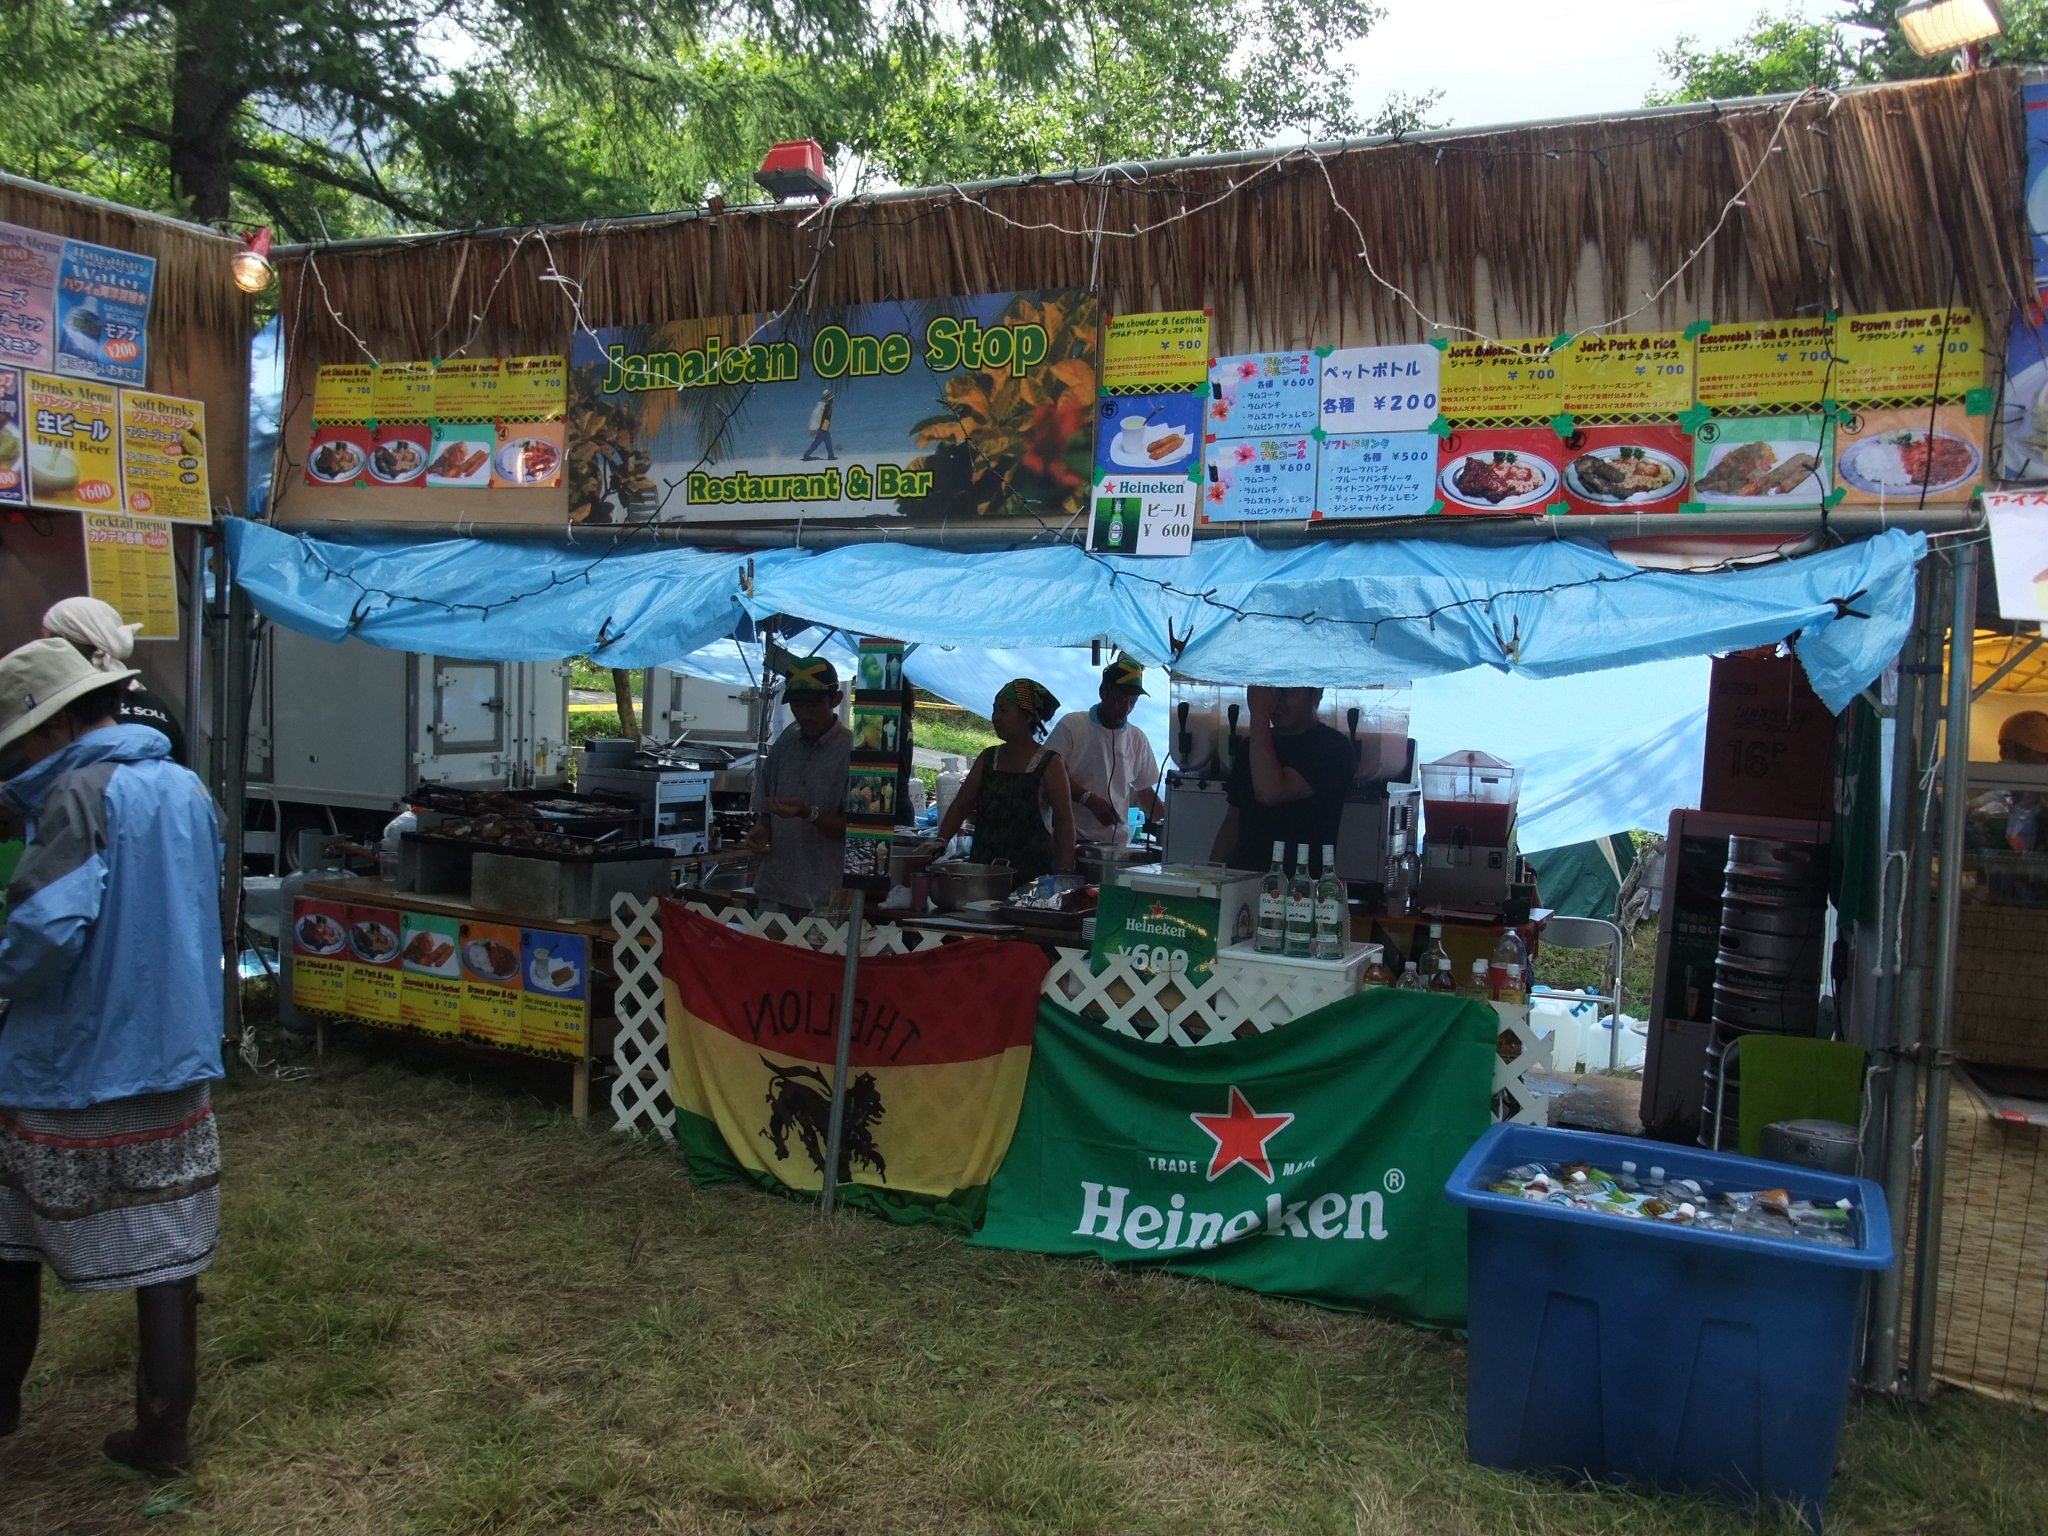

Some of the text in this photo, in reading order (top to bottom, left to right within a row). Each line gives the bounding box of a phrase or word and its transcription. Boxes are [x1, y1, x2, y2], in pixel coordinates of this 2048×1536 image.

[72, 264, 143, 290] Water
[1126, 317, 1160, 328] chowder
[1171, 315, 1207, 325] festivals
[1850, 319, 1891, 333] Brown
[1895, 316, 1927, 330] stew
[1930, 313, 1942, 326] &
[104, 323, 141, 341] モアナ
[1754, 328, 1777, 340] Fish
[1779, 327, 1789, 339] &
[1178, 340, 1201, 350] 500
[1448, 346, 1473, 358] Jerk
[1579, 338, 1677, 353] Jerk Pork & rice
[602, 315, 1049, 395] Jamaican One Stop
[1799, 350, 1830, 362] 700
[1263, 366, 1309, 376] アルコール
[1324, 360, 1421, 379] ペットボトル
[1528, 369, 1555, 380] 700
[1657, 364, 1684, 375] 700
[32, 379, 73, 397] Drinks
[78, 386, 112, 403] Menu
[1257, 378, 1314, 389] 各種 ¥600
[33, 393, 112, 414] ドリンクメニュー
[131, 398, 194, 418] Soft Drinks
[1323, 393, 1437, 414] 各種 ¥200
[37, 409, 110, 442] 生ビール
[132, 411, 194, 429] ソフトドリンク
[37, 434, 111, 456] Draft Beer
[1261, 440, 1306, 450] ラムベース
[1322, 438, 1390, 450] ソフトドリンク
[1261, 450, 1306, 461] アルコール
[1363, 451, 1428, 463] 各種 ¥500
[1254, 463, 1311, 473] 各種 ¥600
[78, 483, 112, 501] ¥600
[688, 464, 933, 505] Restaurant & Bar
[1119, 481, 1185, 494] Heineken
[1147, 503, 1188, 518] ビール
[88, 514, 167, 531] Cocktail menu
[1162, 523, 1190, 537] 600
[90, 529, 144, 545] カクテル各種
[1125, 917, 1186, 938] Heineken
[1148, 1156, 1198, 1175] TRADE
[1071, 1180, 1390, 1251] Heineken
